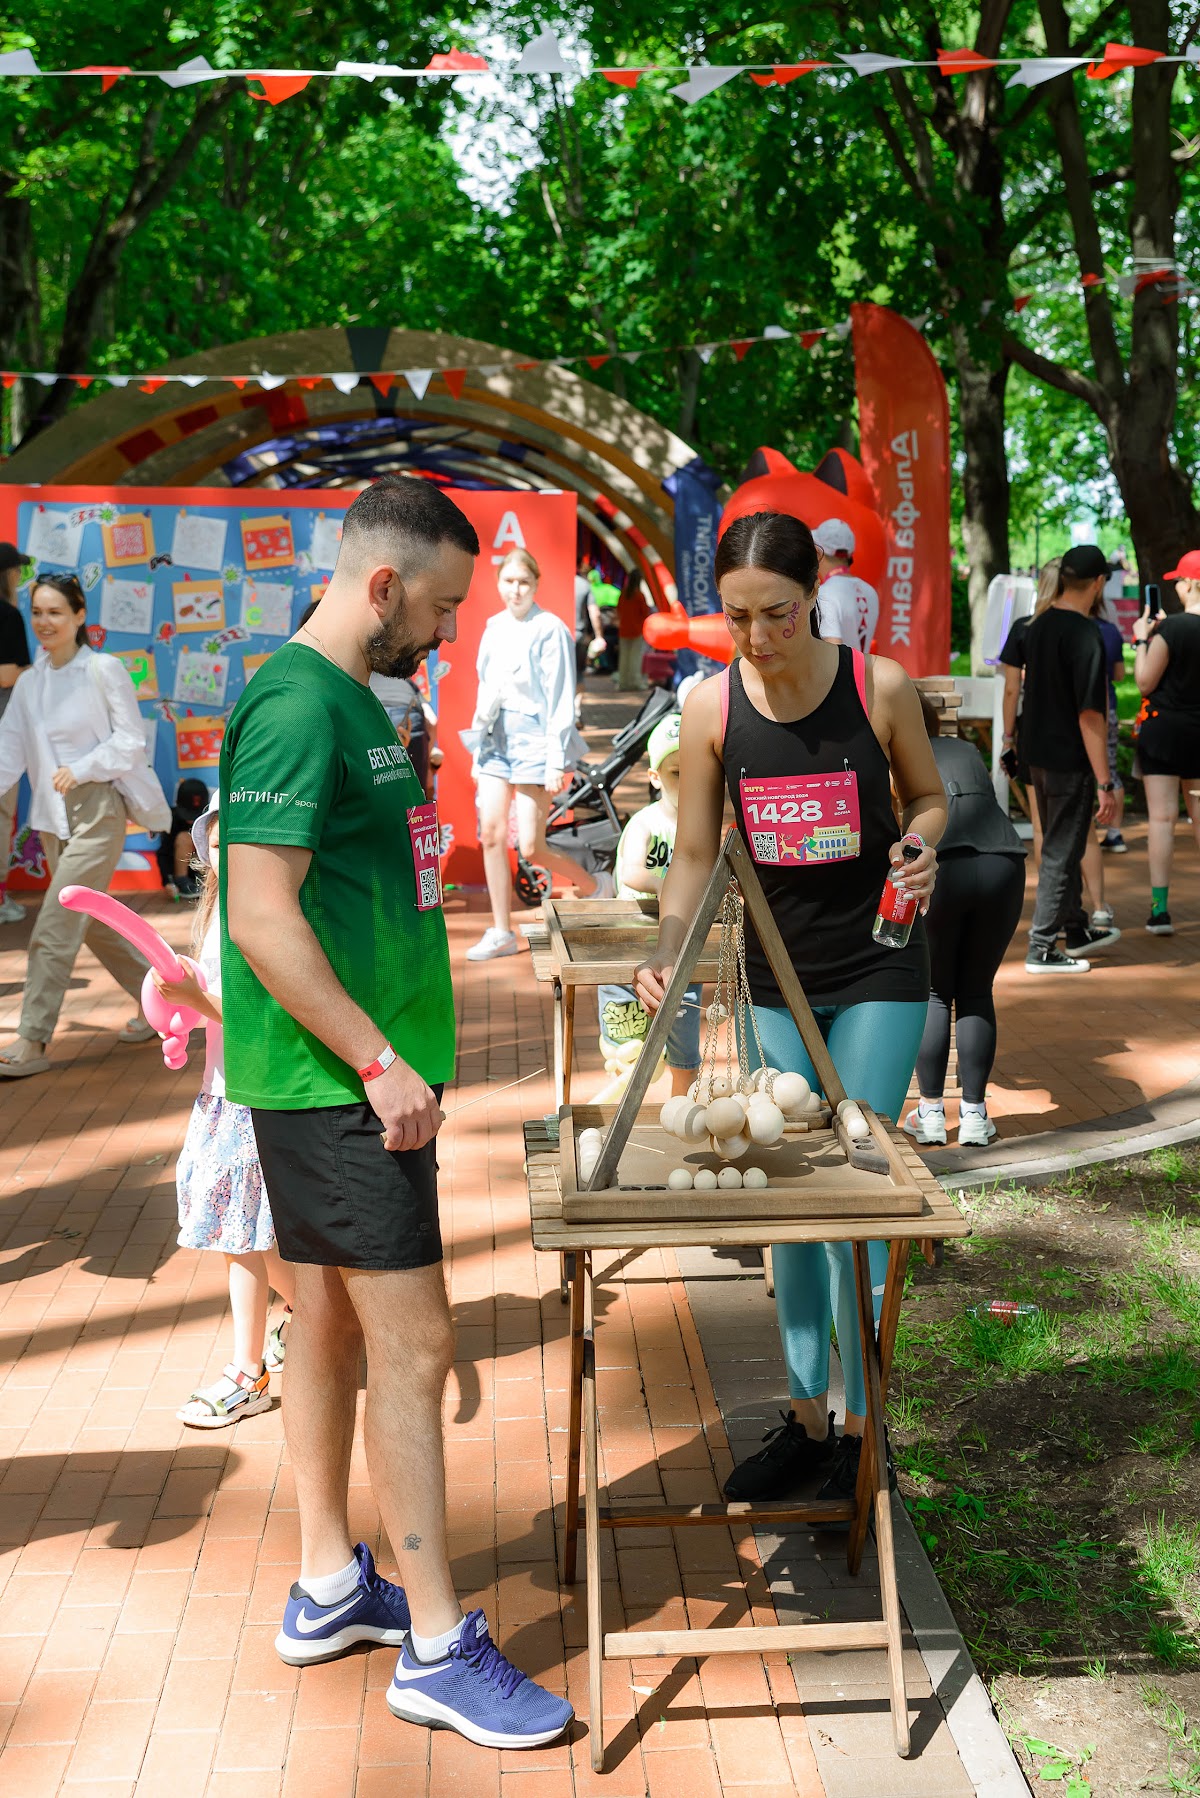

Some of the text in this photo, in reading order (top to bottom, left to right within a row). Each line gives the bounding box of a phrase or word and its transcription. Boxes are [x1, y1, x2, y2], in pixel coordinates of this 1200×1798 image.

[744, 785, 765, 793] RUTS
[747, 799, 847, 824] 1428 3
